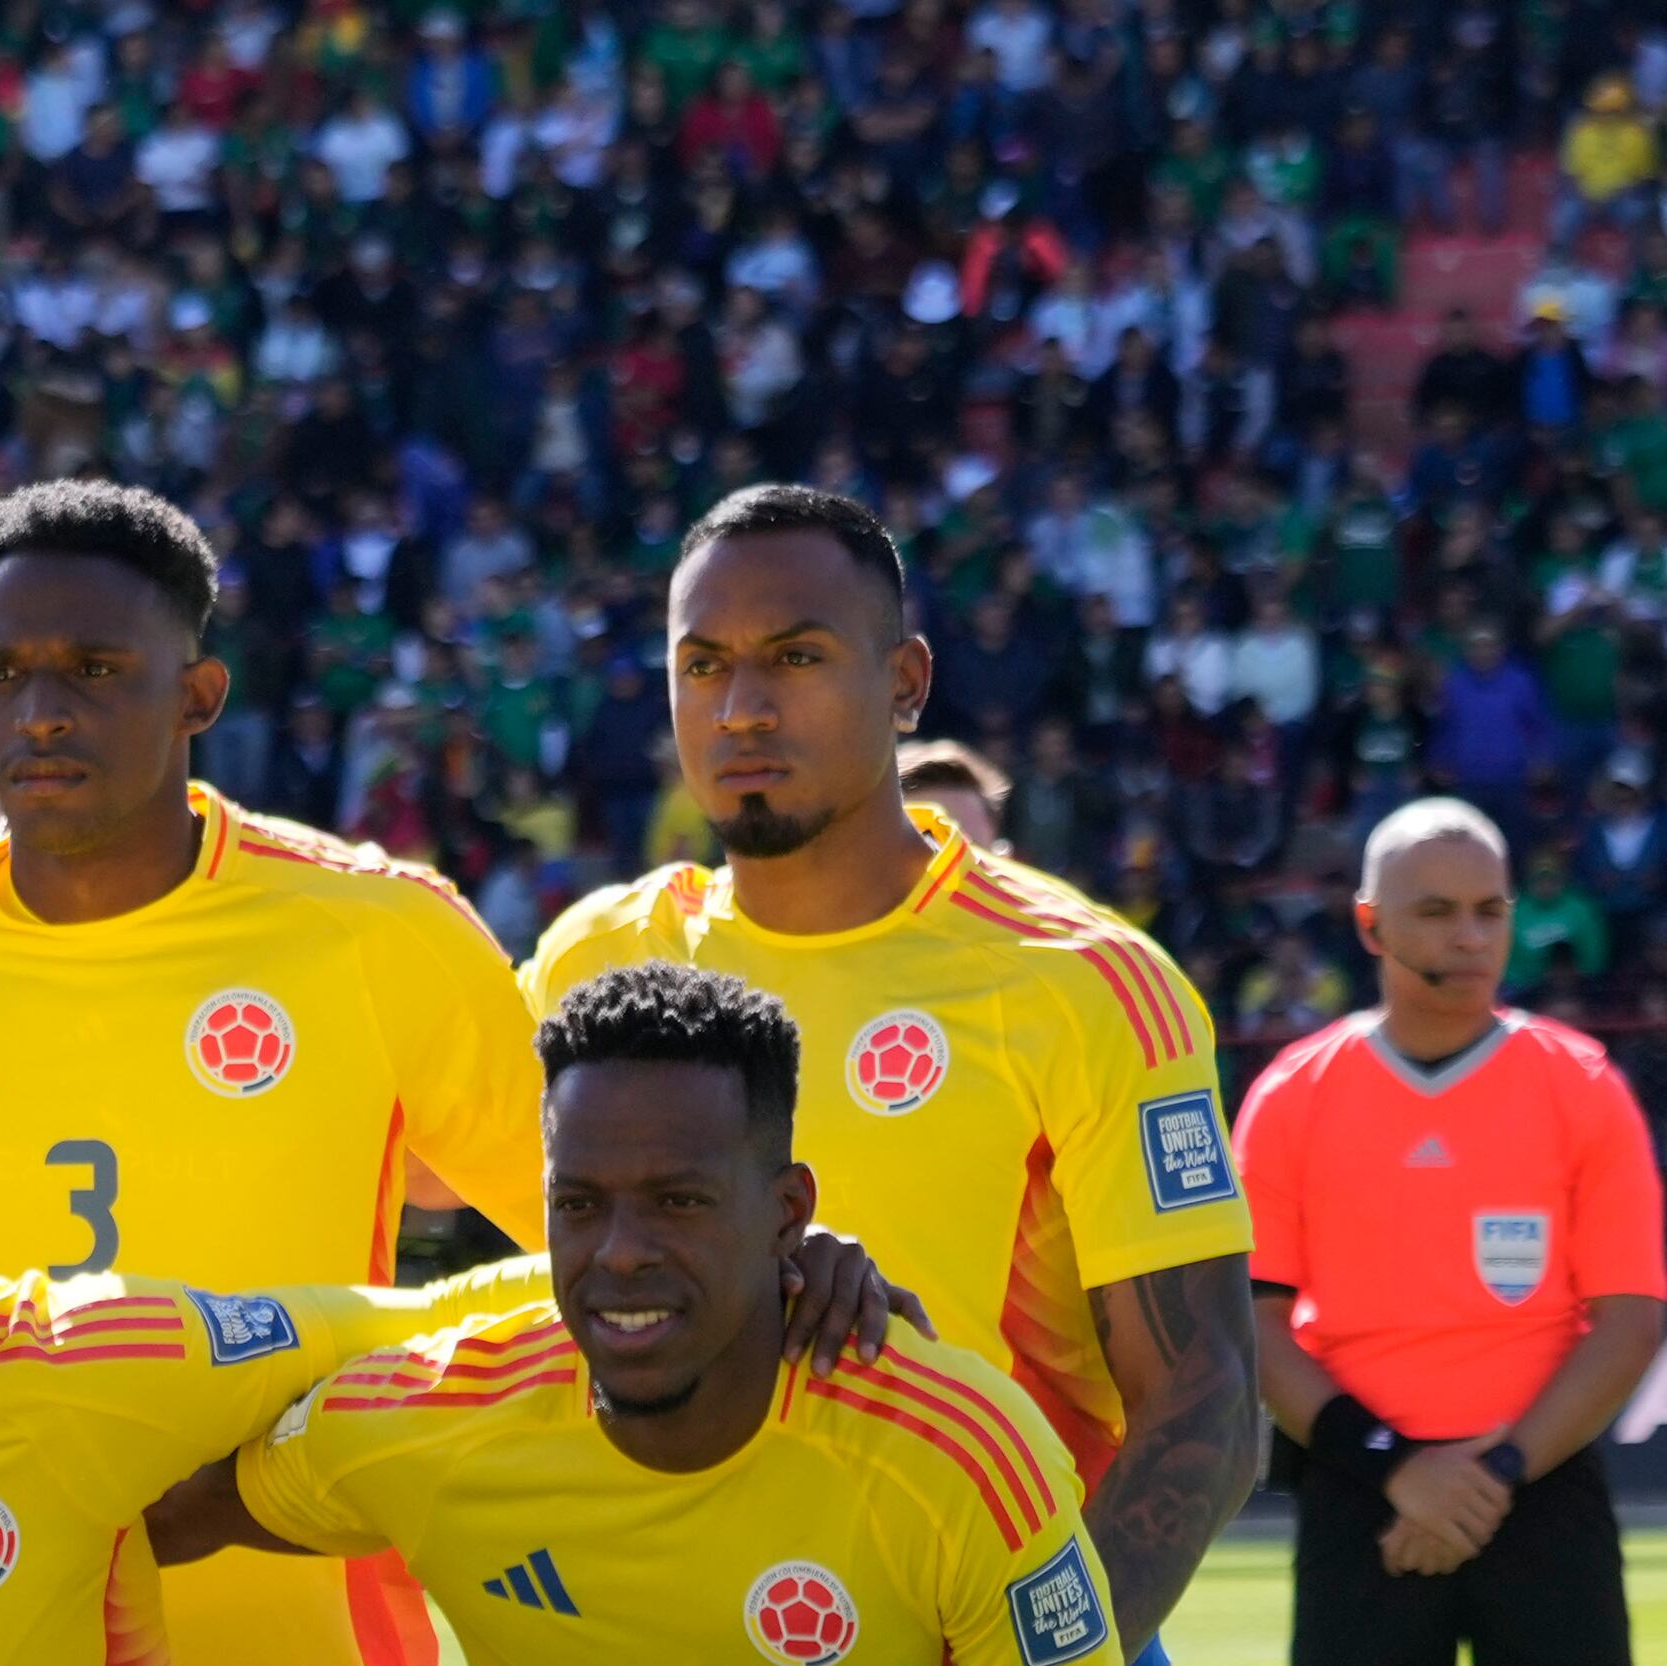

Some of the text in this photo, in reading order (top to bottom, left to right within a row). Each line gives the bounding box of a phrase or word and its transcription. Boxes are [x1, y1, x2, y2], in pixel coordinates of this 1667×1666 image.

[1158, 1111, 1207, 1133] FOOTBALL
[1161, 1125, 1213, 1153] UNITES
[1163, 1153, 1184, 1173] the
[1187, 1173, 1207, 1185] FIFA
[45, 1139, 119, 1283] 3
[1483, 1221, 1539, 1241] FIFA
[1029, 1564, 1078, 1601] FOOTBALL
[1032, 1577, 1083, 1617] UNITES
[1032, 1615, 1058, 1635] the
[1060, 1627, 1082, 1643] FIFA
